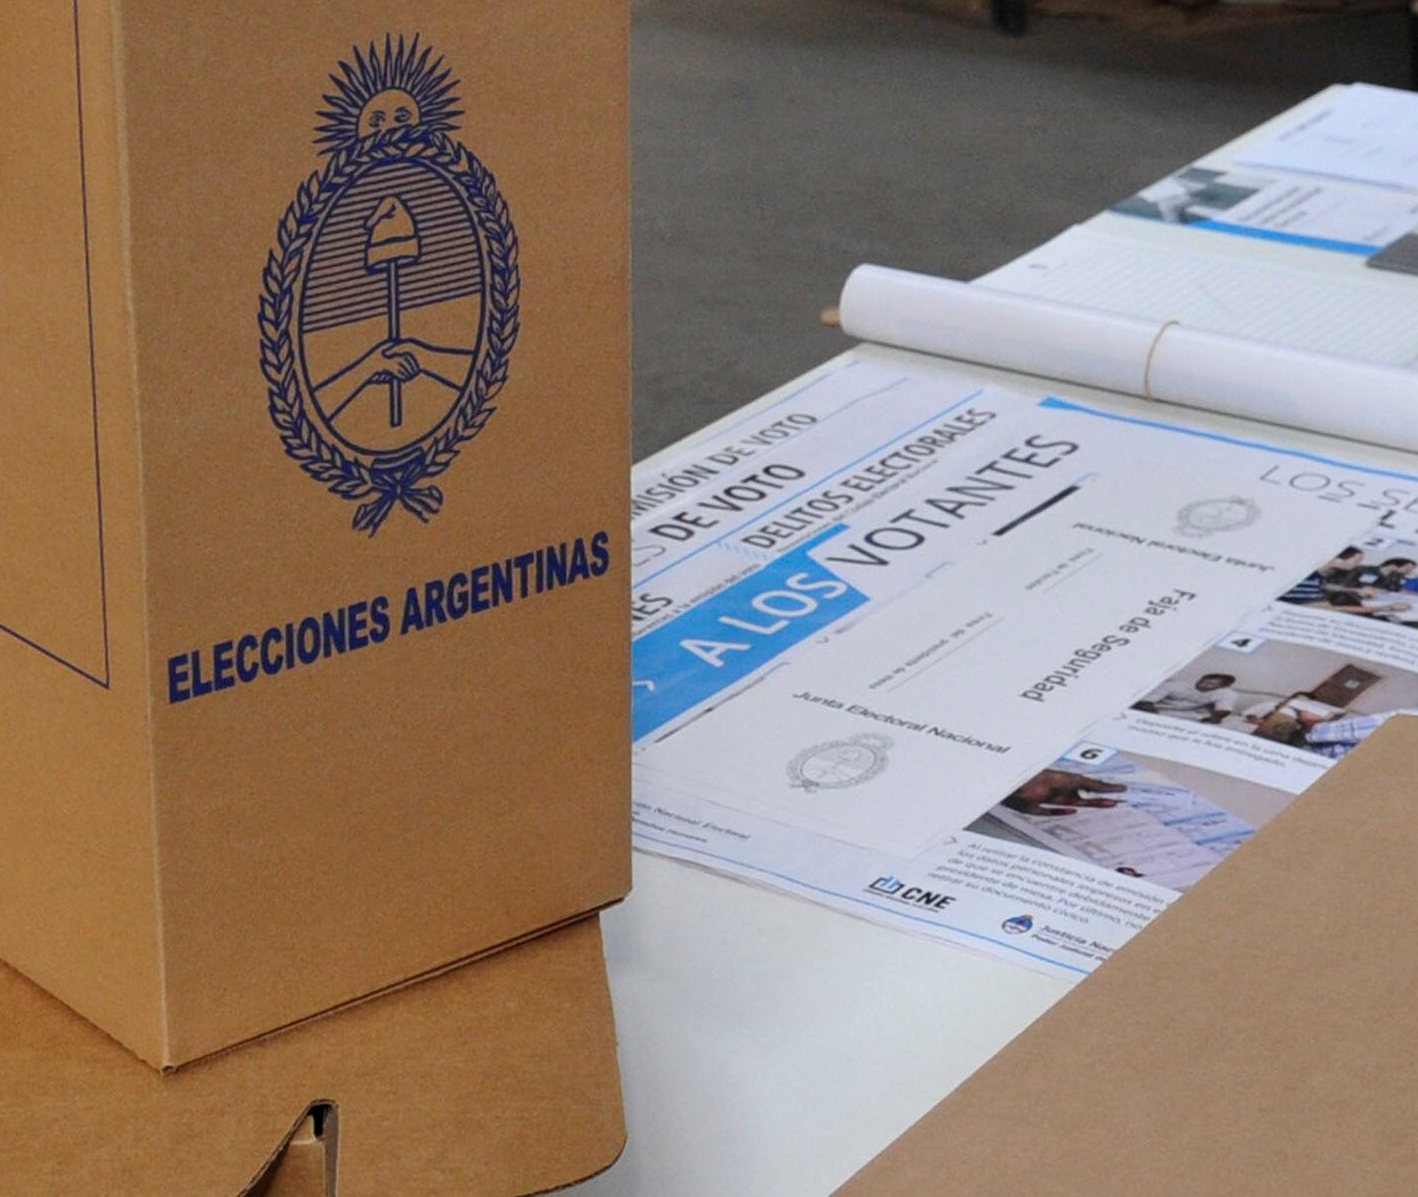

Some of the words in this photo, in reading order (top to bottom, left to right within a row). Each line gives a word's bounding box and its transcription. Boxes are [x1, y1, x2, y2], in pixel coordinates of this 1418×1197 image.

[705, 446, 756, 466] DE
[739, 412, 818, 446] VOTO
[648, 511, 720, 542] DE
[697, 463, 807, 513] VOTO
[741, 489, 854, 550] DELITOS
[840, 407, 997, 493] ELECTORALES
[1259, 464, 1366, 500] LOS
[679, 638, 753, 668] A
[717, 571, 851, 636] LOS
[824, 434, 1080, 567] VOTANTES
[168, 595, 390, 704] ELECCIONES
[400, 530, 610, 636] ARGENTINAS
[1118, 614, 1152, 634] de
[1144, 587, 1198, 617] Faja
[1019, 634, 1131, 703] Seguridad
[792, 691, 845, 709] Junta
[845, 703, 928, 733] Electoral
[925, 725, 1012, 755] Nacional
[1080, 748, 1104, 761] 6
[900, 886, 957, 910] CNE
